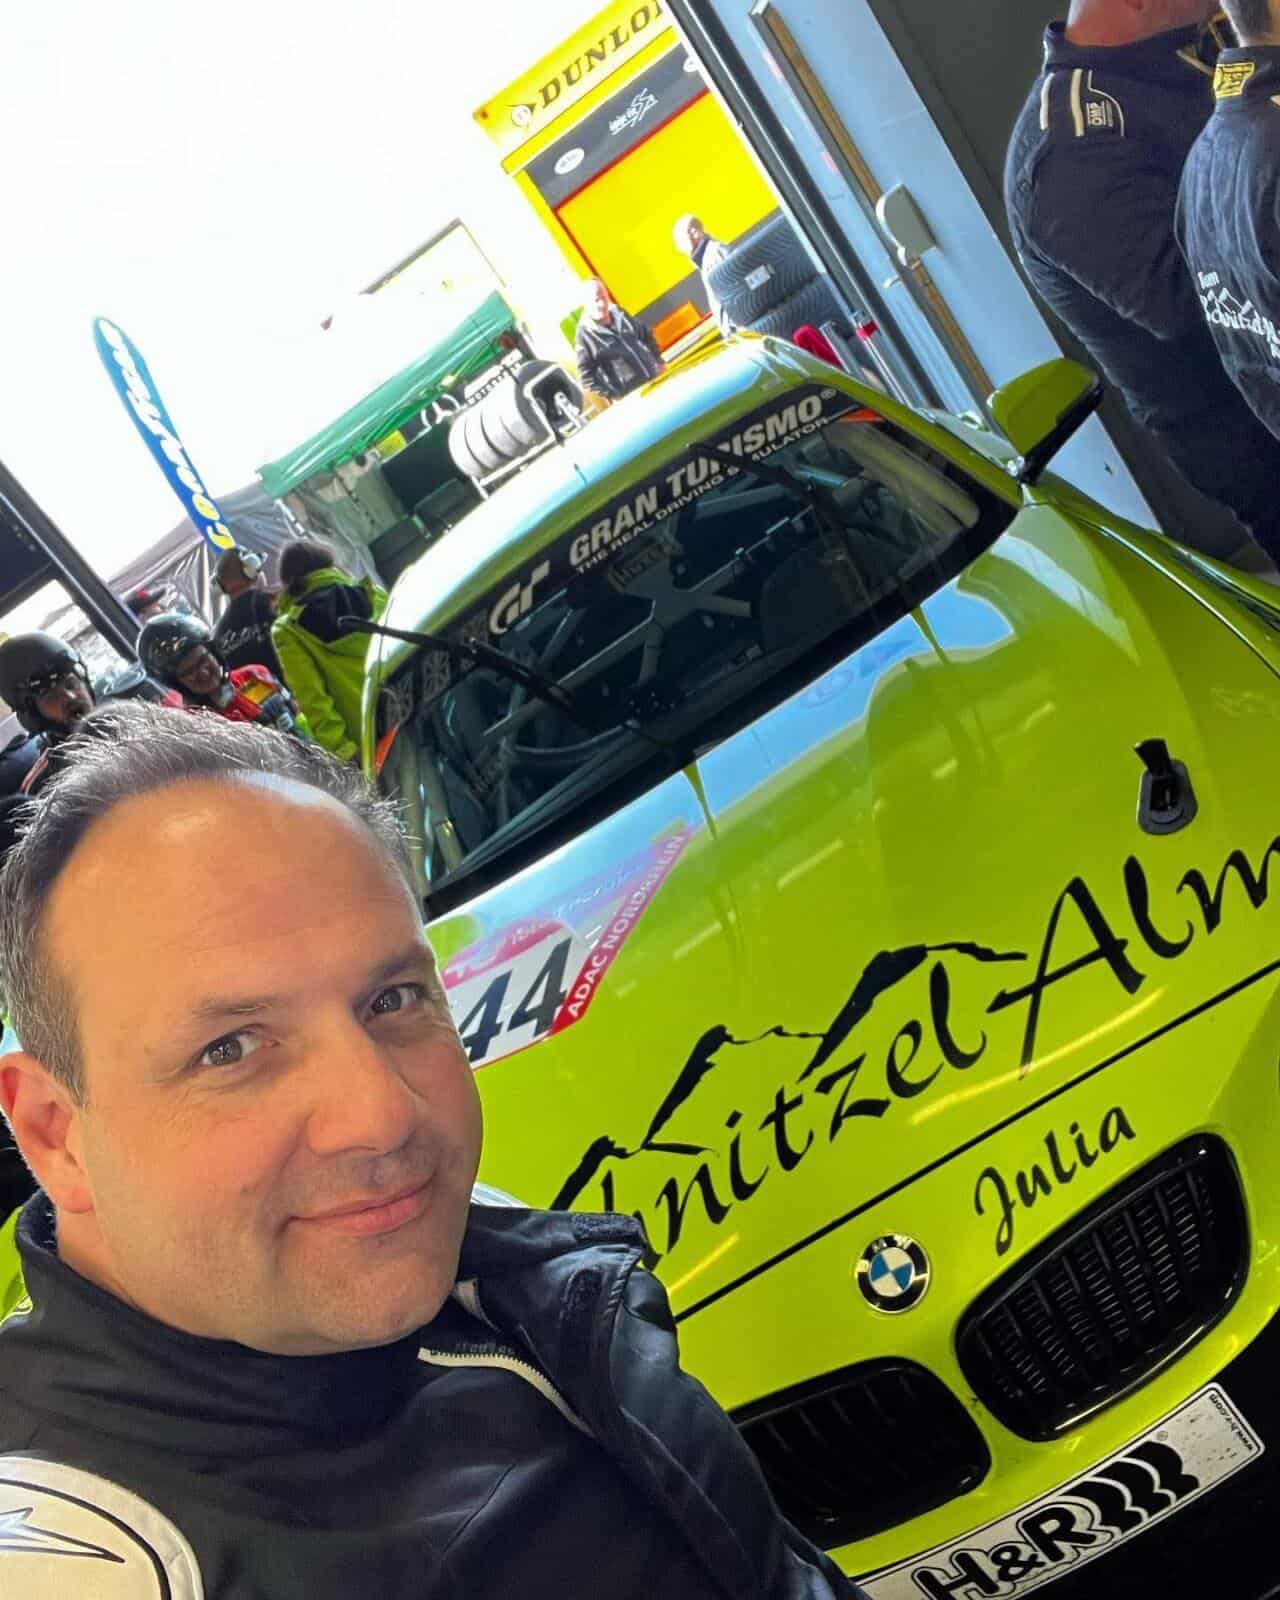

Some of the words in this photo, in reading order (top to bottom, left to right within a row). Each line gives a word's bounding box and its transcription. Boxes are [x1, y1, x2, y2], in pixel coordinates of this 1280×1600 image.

[569, 487, 658, 565] GRAN
[576, 551, 609, 574] THE
[610, 520, 654, 552] REAL
[655, 475, 720, 520] DRIVING
[725, 418, 831, 476] SULATOR
[459, 937, 571, 1062] 44
[567, 954, 608, 1017] ADAC
[974, 1106, 1136, 1256] Julia
[915, 1505, 1100, 1600] H&R
